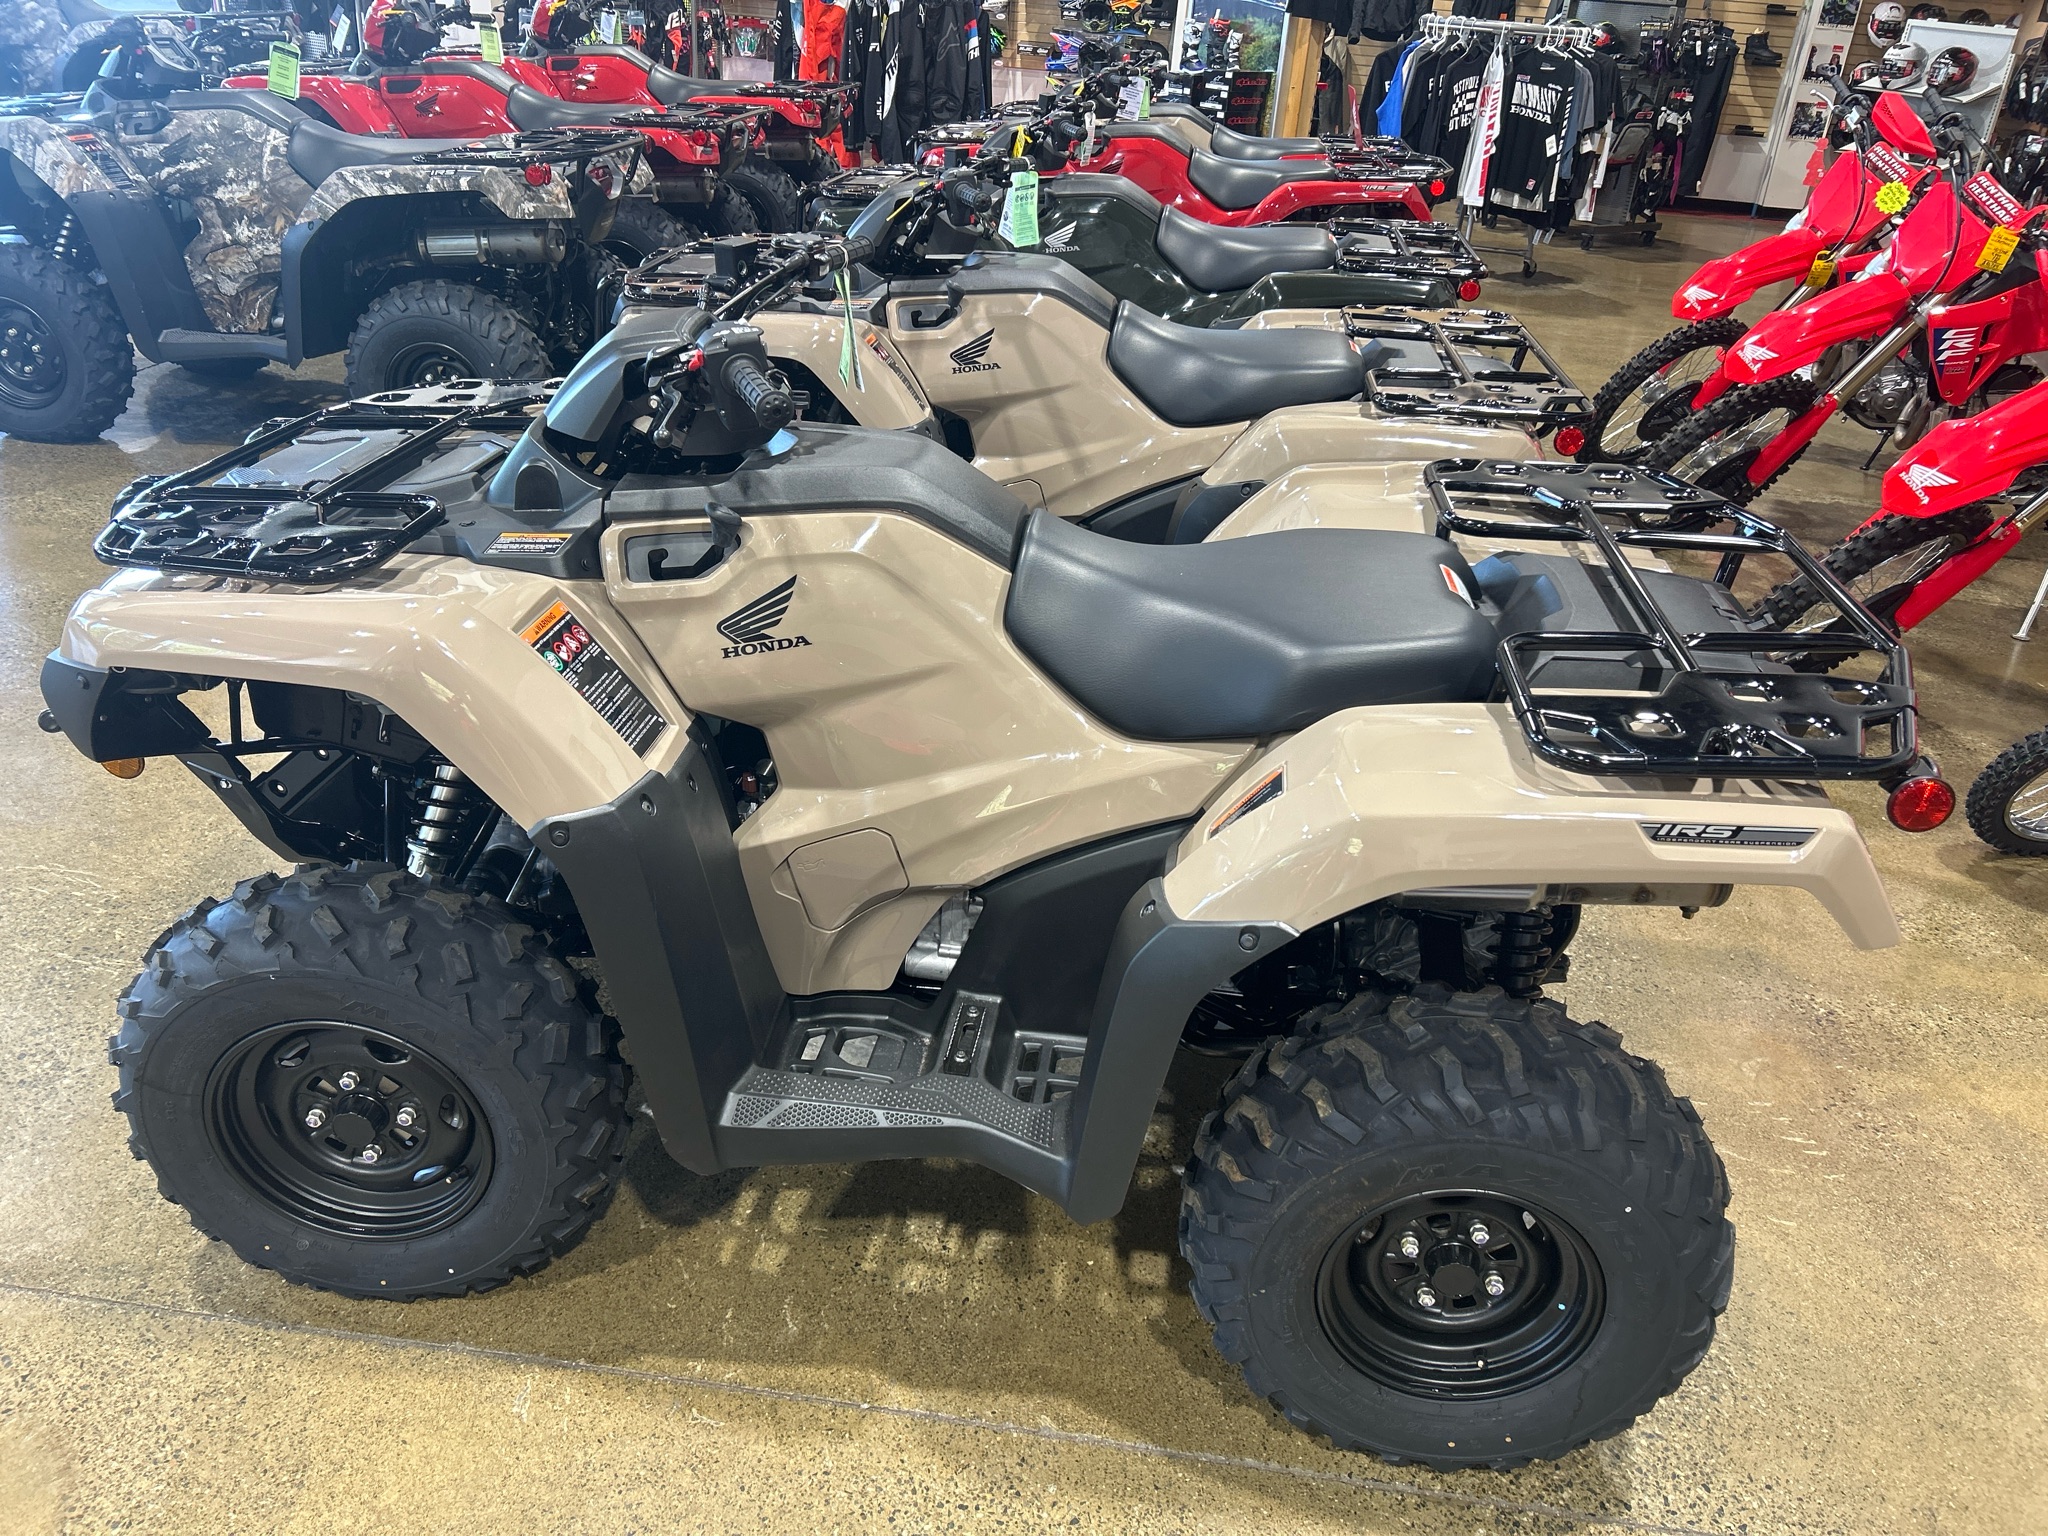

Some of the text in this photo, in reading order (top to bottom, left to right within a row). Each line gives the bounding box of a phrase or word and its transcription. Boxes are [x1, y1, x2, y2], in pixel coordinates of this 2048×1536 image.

[1509, 104, 1552, 125] HONDA
[1873, 145, 1910, 179] RENTHAL
[1976, 175, 2020, 216] RENTHAL
[1045, 245, 1080, 254] HONDA
[1935, 326, 1980, 362] CRF
[951, 361, 1002, 375] HONDA
[1735, 349, 1758, 375] HONDA
[1899, 470, 1930, 506] HONDA
[721, 634, 813, 659] HONDA
[1657, 824, 1737, 838] IRS
